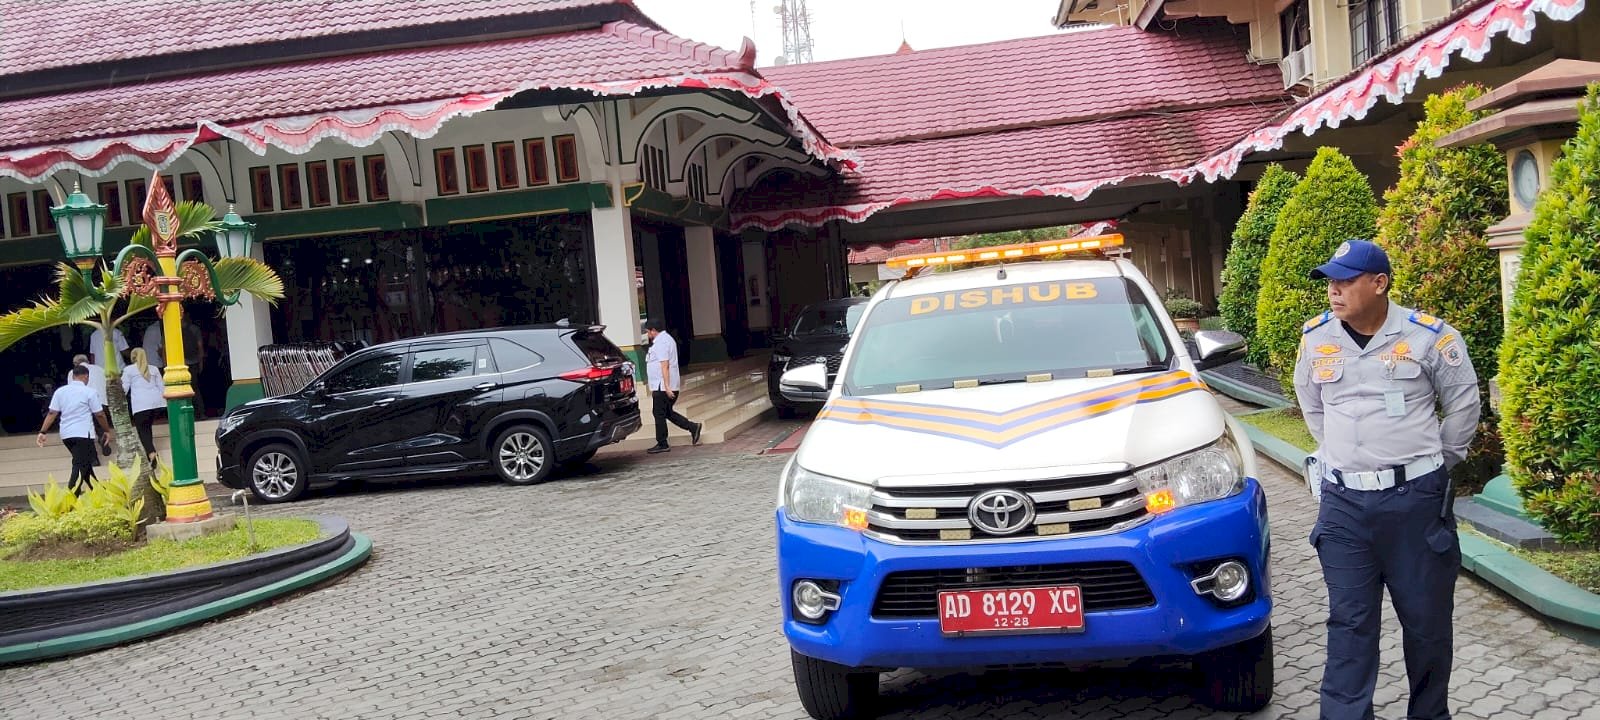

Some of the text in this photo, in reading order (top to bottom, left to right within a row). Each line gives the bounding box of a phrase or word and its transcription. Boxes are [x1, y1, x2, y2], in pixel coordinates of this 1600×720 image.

[910, 282, 1098, 315] DISHUB
[945, 590, 1077, 618] AD 8129 XC
